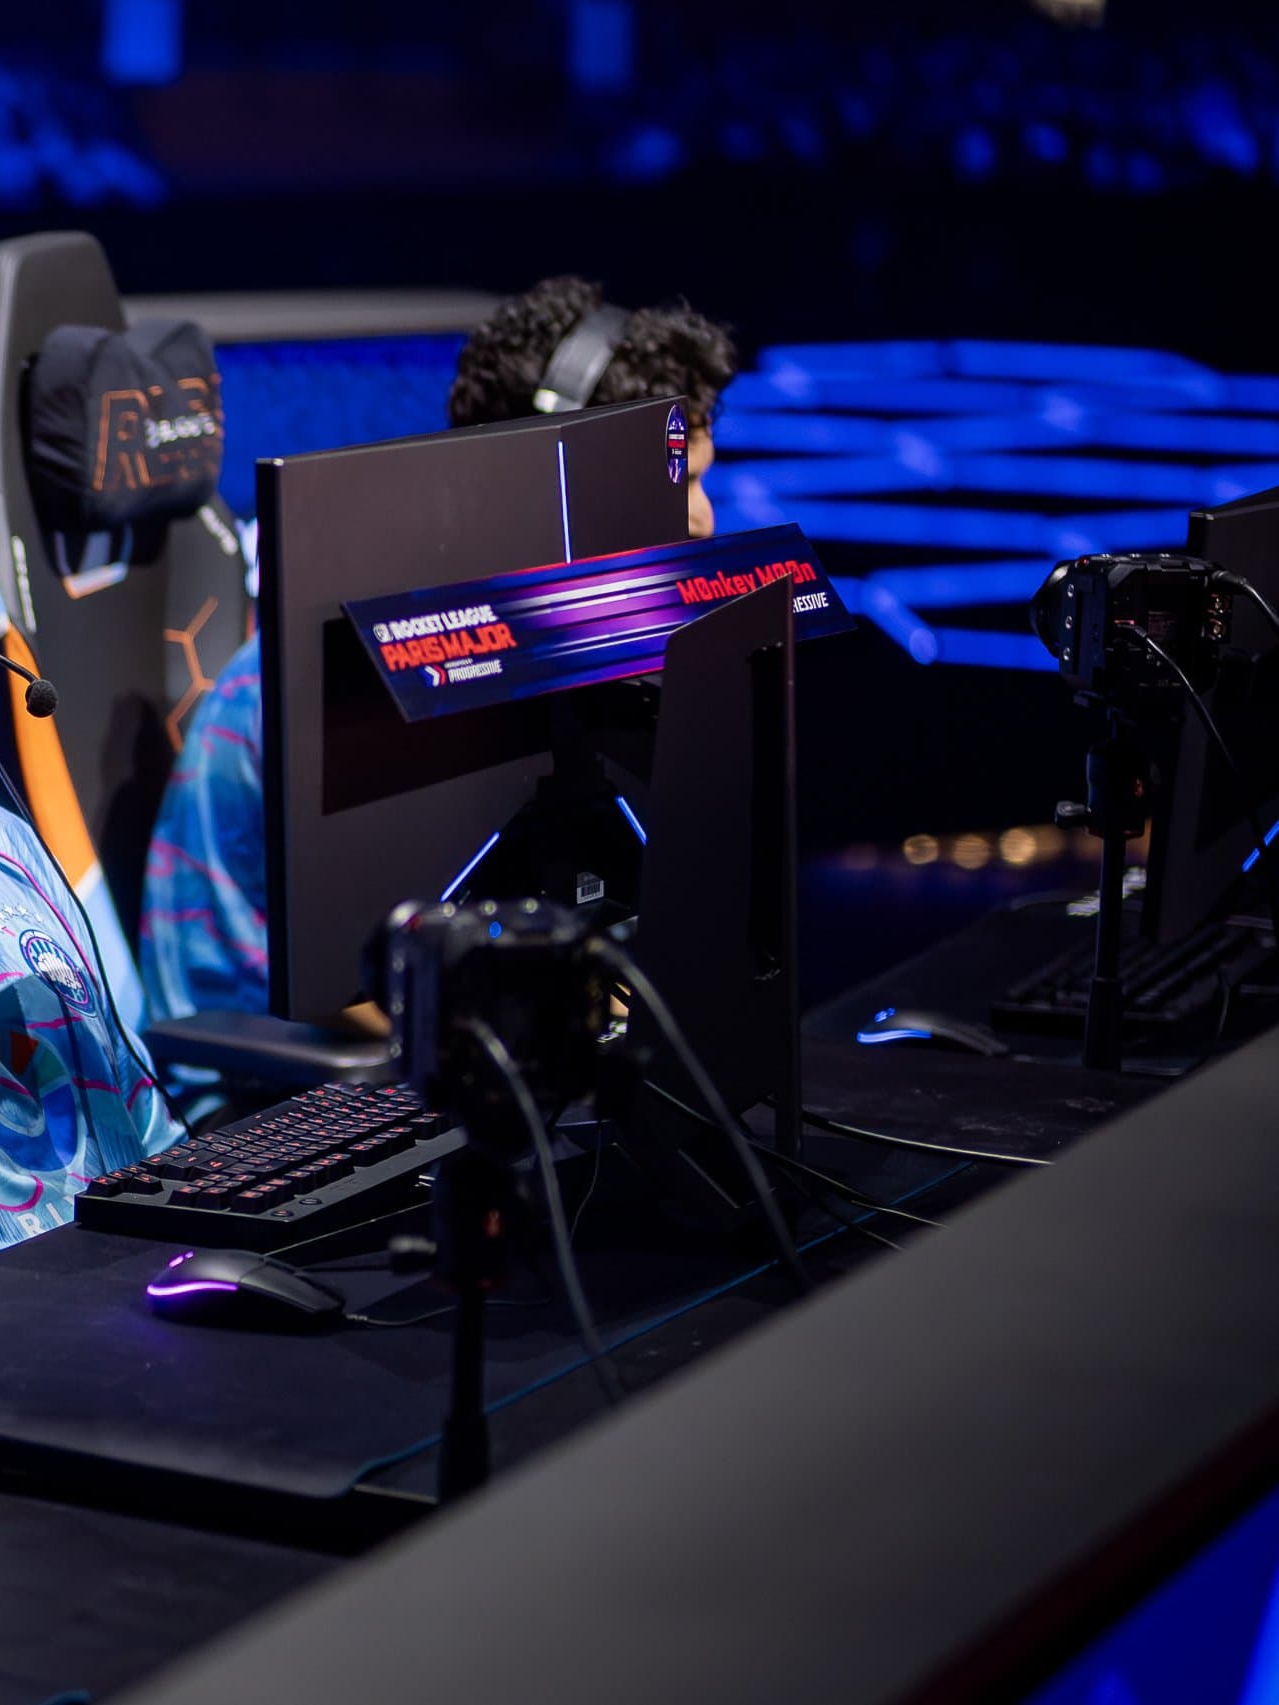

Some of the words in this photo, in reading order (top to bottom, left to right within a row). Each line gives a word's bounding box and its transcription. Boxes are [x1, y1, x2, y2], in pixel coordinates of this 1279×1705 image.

[441, 604, 499, 630] LEAGUE
[380, 634, 445, 672] PARIS
[439, 622, 517, 659] MAJOR
